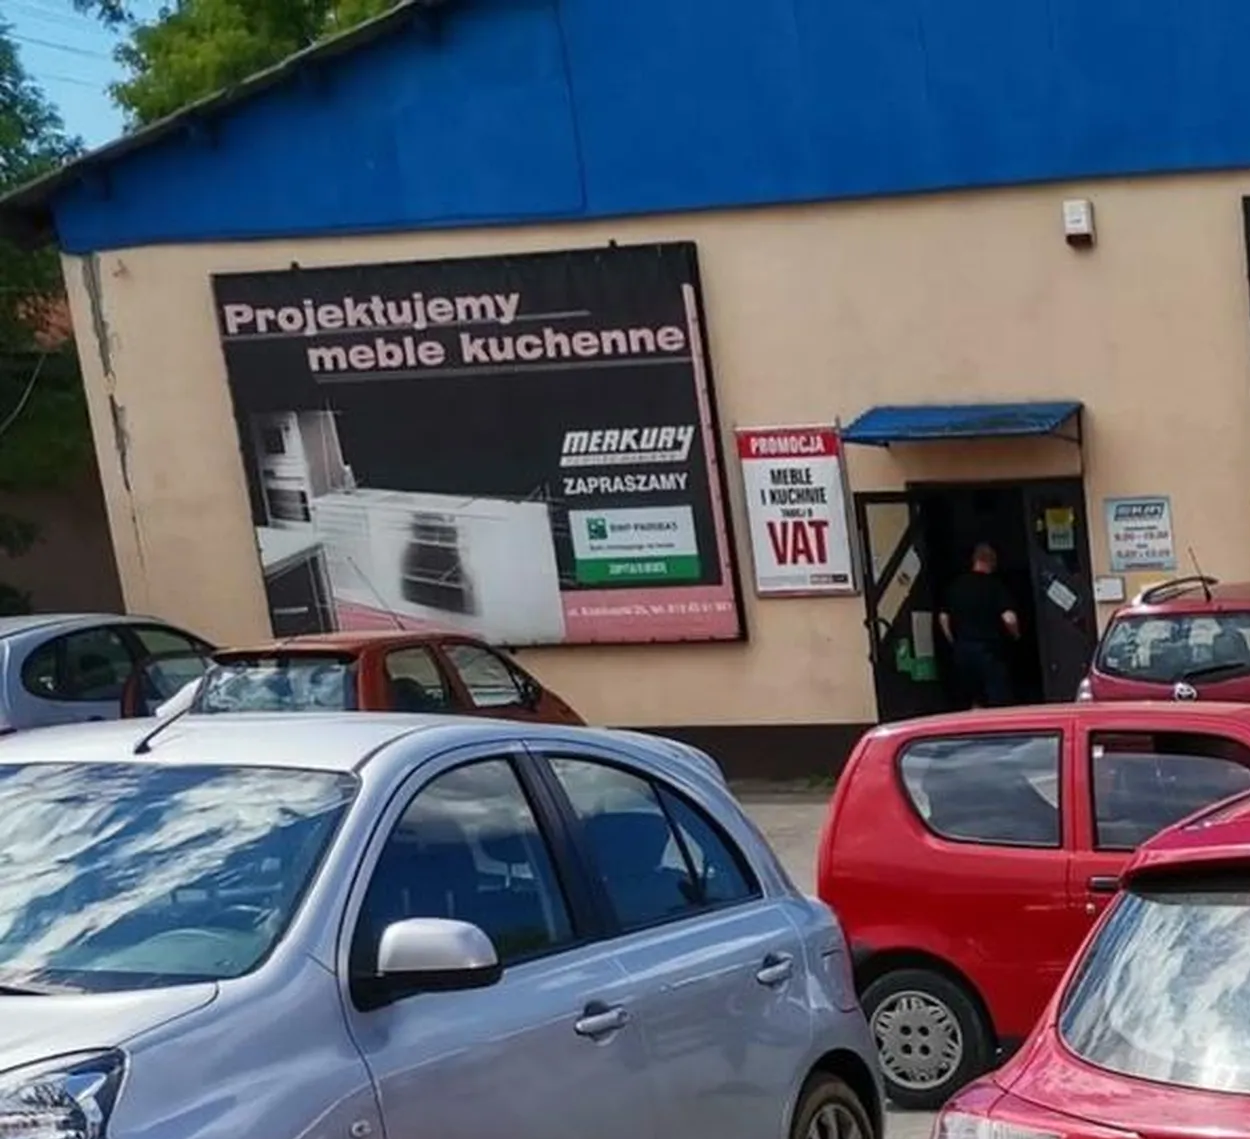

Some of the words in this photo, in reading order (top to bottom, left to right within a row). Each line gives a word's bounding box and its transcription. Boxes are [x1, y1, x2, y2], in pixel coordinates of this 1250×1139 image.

[224, 292, 519, 335] Projektujemy
[307, 336, 444, 371] meble
[459, 325, 684, 363] kuchenne
[562, 425, 695, 458] MERKURY
[750, 435, 826, 455] PROMOCJA
[563, 472, 688, 495] ZAPRASZAMY
[770, 467, 813, 486] MEBLE
[766, 520, 829, 566] VAT
